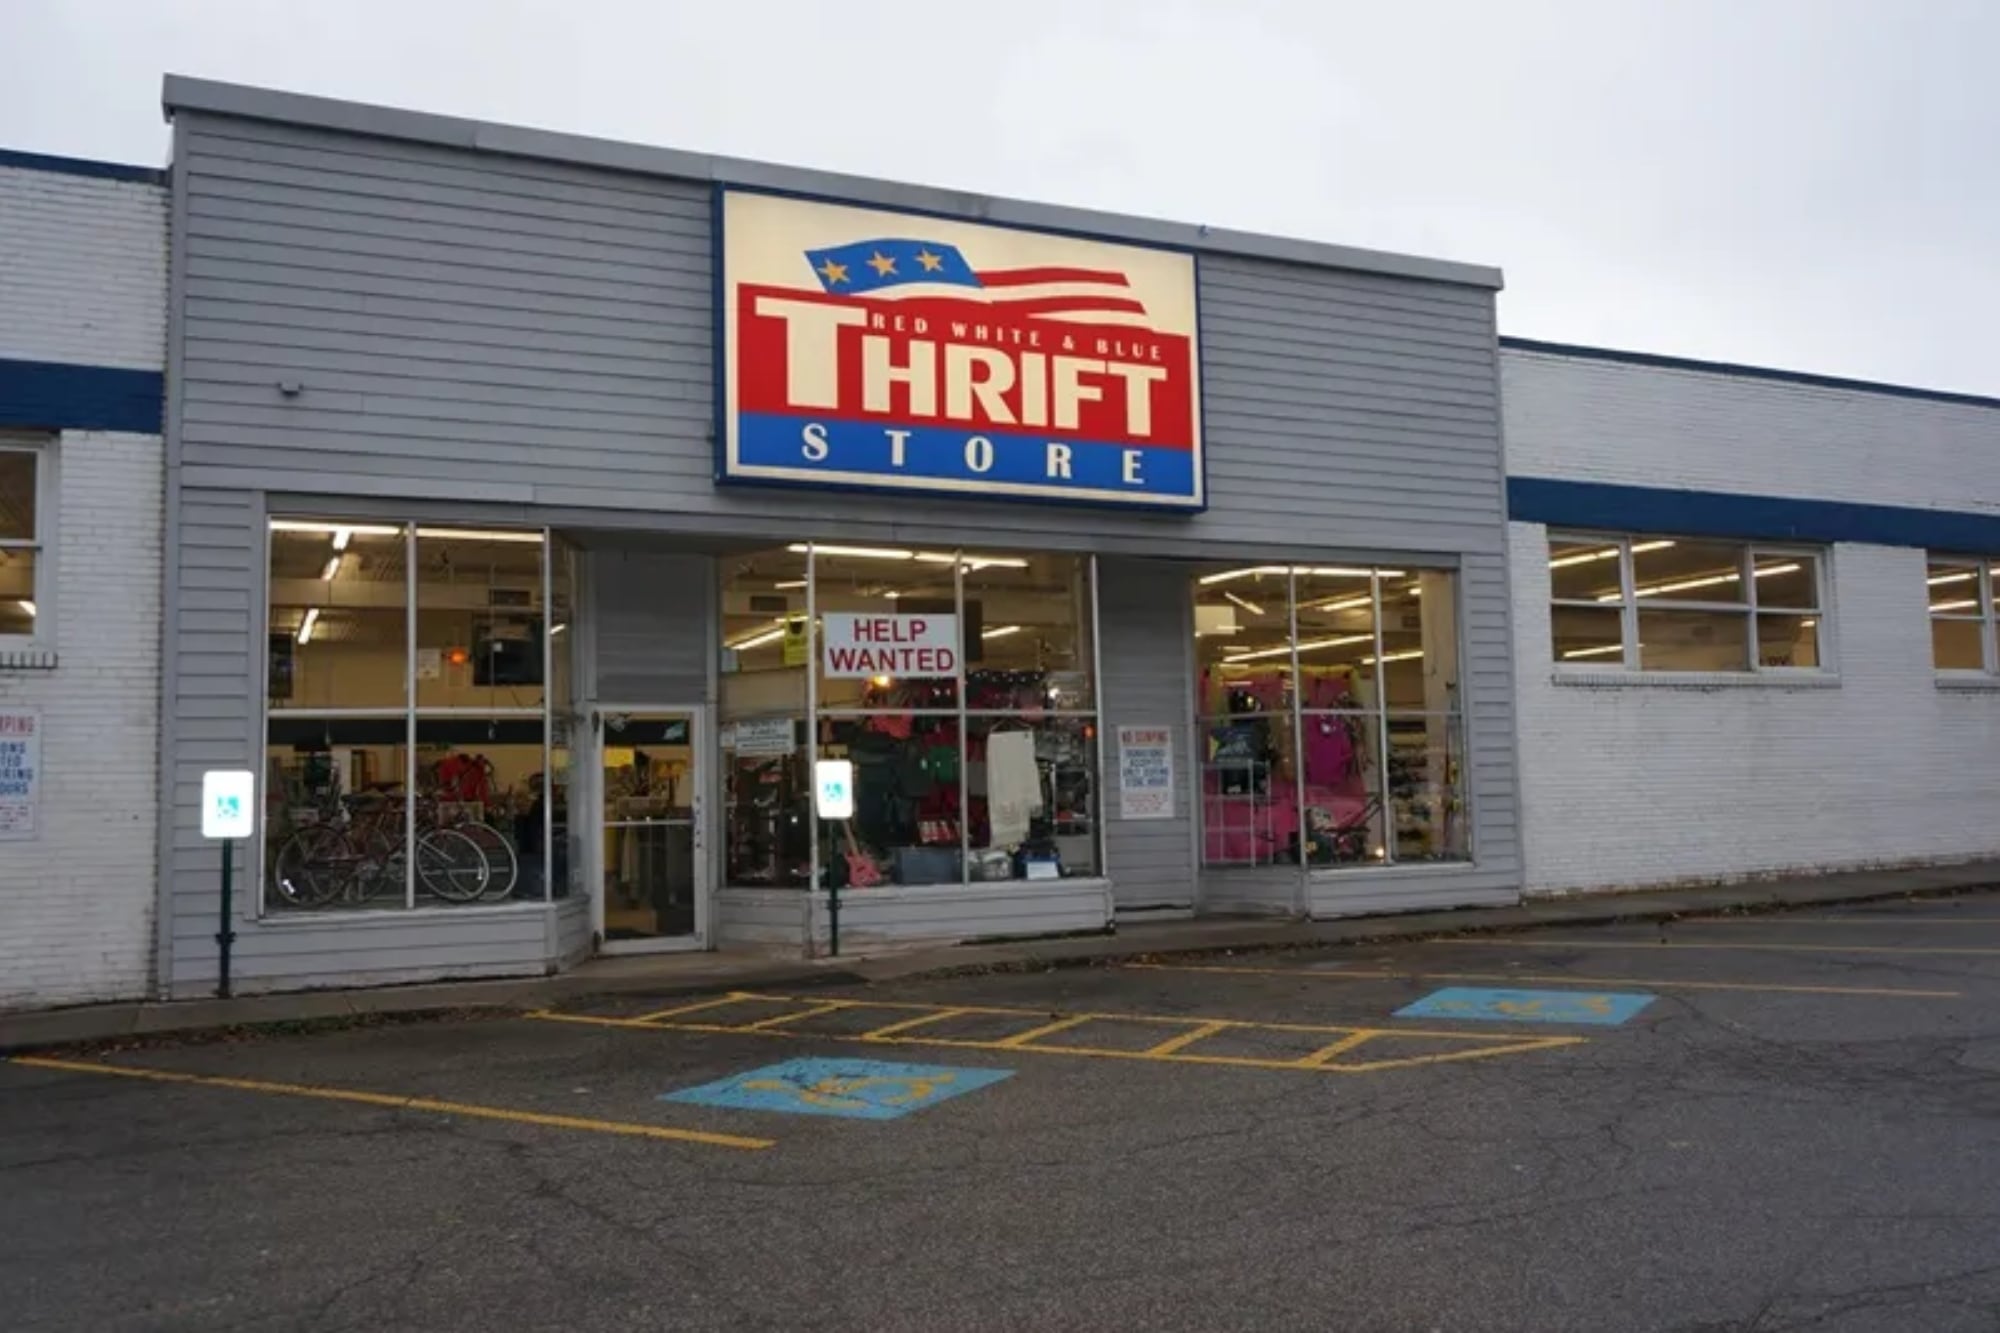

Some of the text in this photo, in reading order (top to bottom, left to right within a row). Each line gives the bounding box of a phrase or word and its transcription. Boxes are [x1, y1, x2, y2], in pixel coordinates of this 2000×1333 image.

[872, 312, 1161, 361] RED WHITE & BLUE
[755, 296, 1167, 437] THRIFT
[801, 423, 1144, 484] STORE
[853, 618, 927, 643] HELP
[829, 648, 955, 672] WANTED
